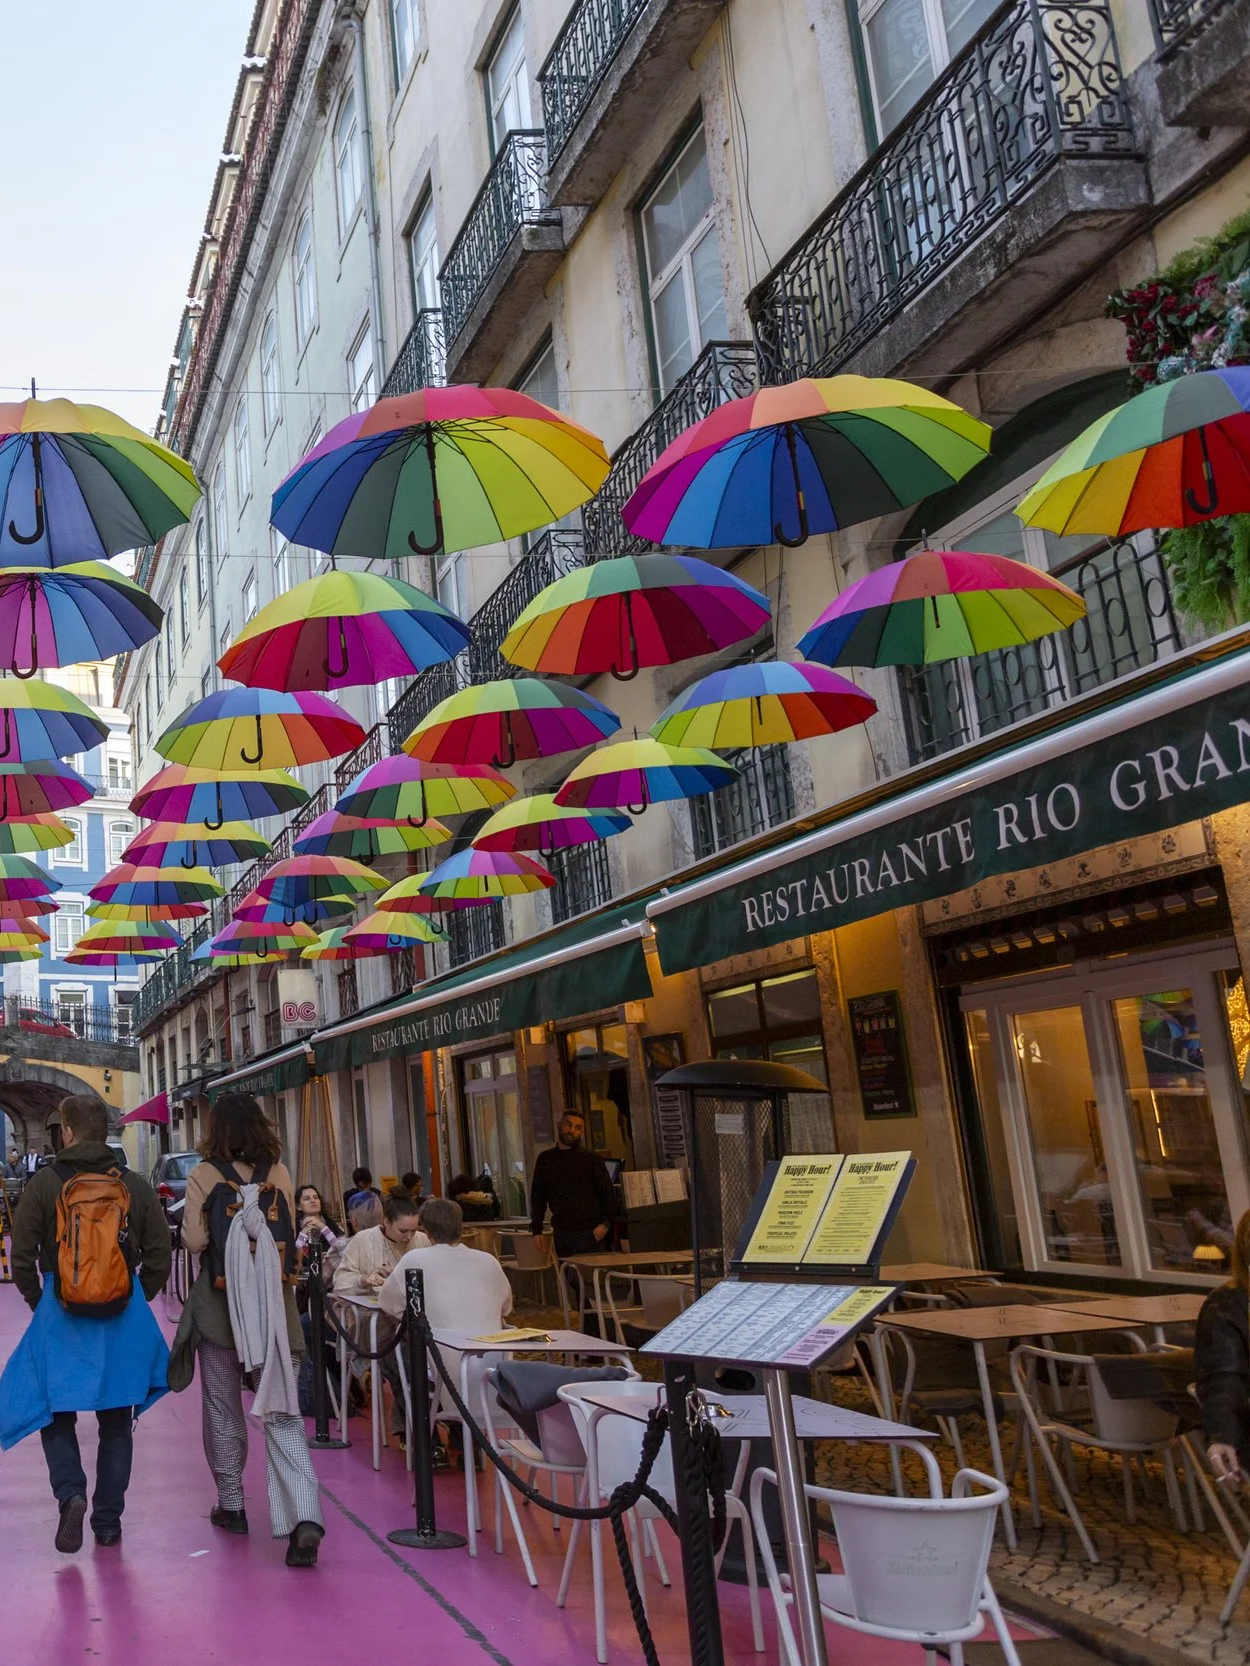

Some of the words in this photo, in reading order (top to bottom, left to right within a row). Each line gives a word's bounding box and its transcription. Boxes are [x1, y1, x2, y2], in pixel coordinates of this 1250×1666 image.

[742, 818, 976, 934] RESTAURANTE
[997, 782, 1082, 851] RIO
[282, 1001, 316, 1023] BC
[371, 1018, 431, 1053] RESTAURANTE
[433, 1011, 452, 1037] RIO
[455, 998, 501, 1031] GRANDE
[784, 1166, 807, 1177] Happy
[808, 1164, 832, 1175] Hour!
[848, 1164, 872, 1175] Happy
[874, 1161, 898, 1172] Hour!
